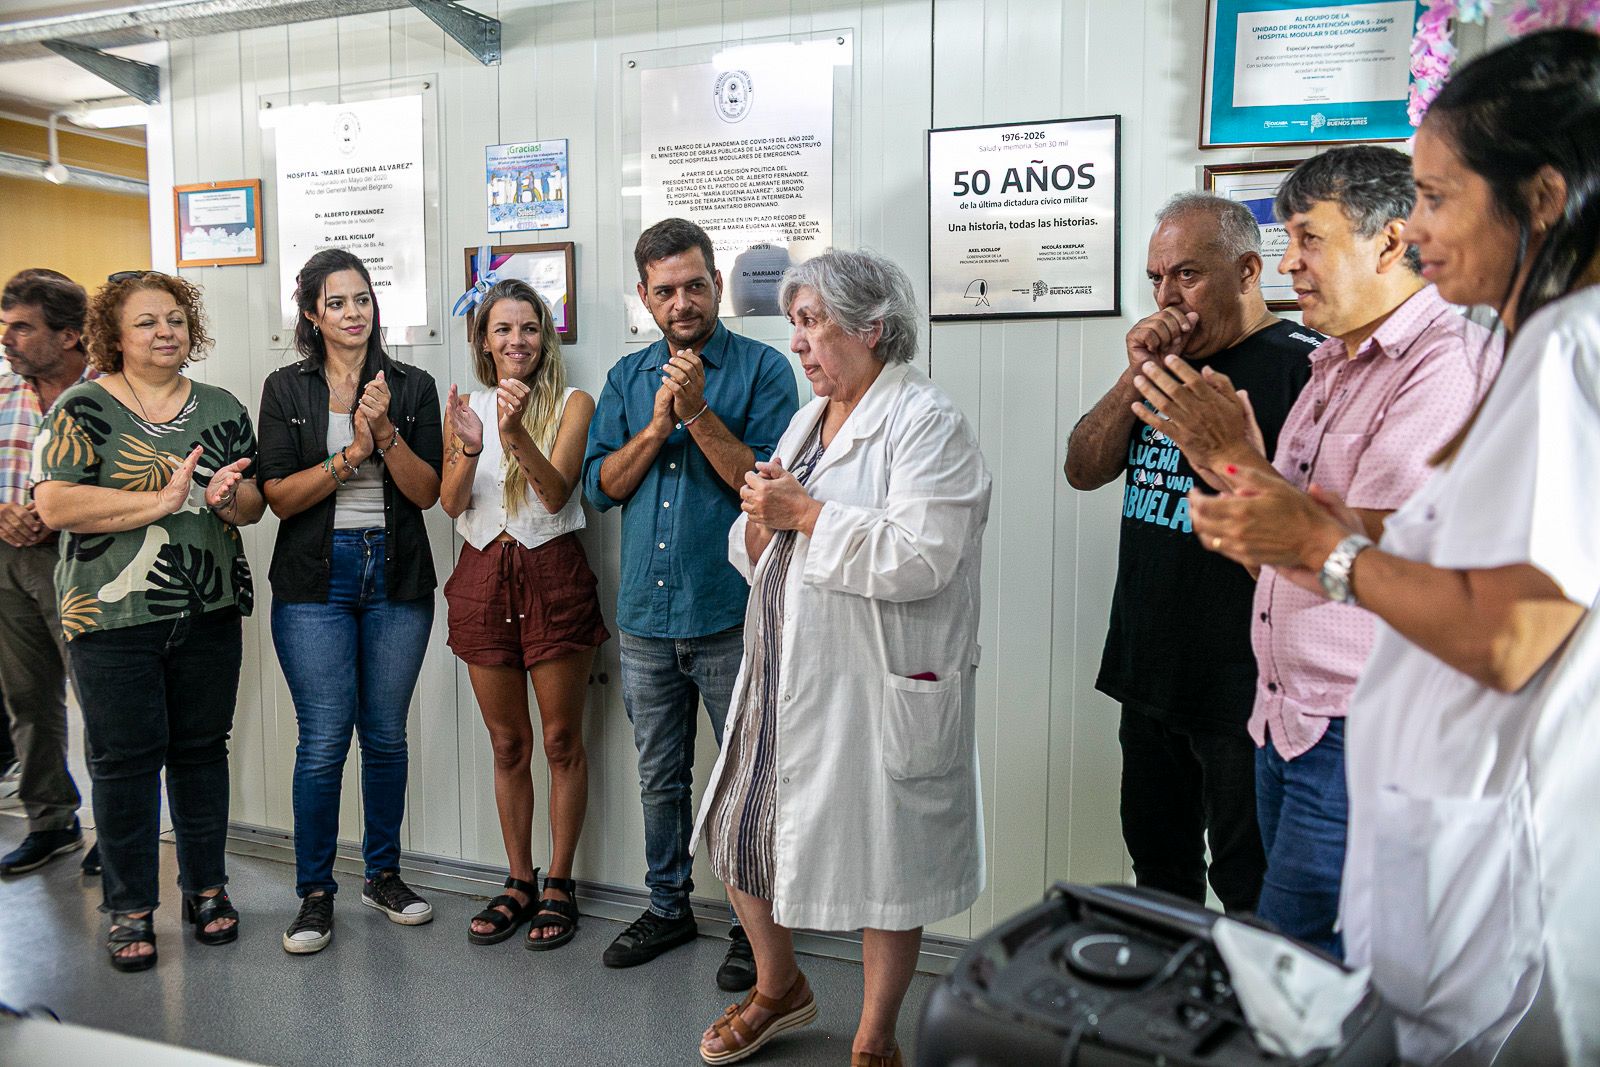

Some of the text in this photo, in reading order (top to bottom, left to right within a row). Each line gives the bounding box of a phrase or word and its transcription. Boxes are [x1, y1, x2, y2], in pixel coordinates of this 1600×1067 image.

[1340, 27, 1387, 35] LONGCHAMPS
[1002, 132, 1045, 142] 1976-2026
[507, 144, 541, 156] ¡Gracias!
[287, 171, 318, 179] HOSPITAL
[347, 166, 376, 174] EUGENIA
[953, 160, 1095, 196] 50 AÑOS
[369, 183, 393, 192] Belgrano
[960, 201, 969, 210] de
[971, 201, 977, 209] la
[979, 200, 1001, 209] última
[1004, 198, 1038, 207] dictadura
[1063, 196, 1088, 204] militar
[948, 217, 1098, 232] Una historia, todas las historias.
[1128, 440, 1180, 473] LUCHA
[1166, 476, 1194, 493] UNA
